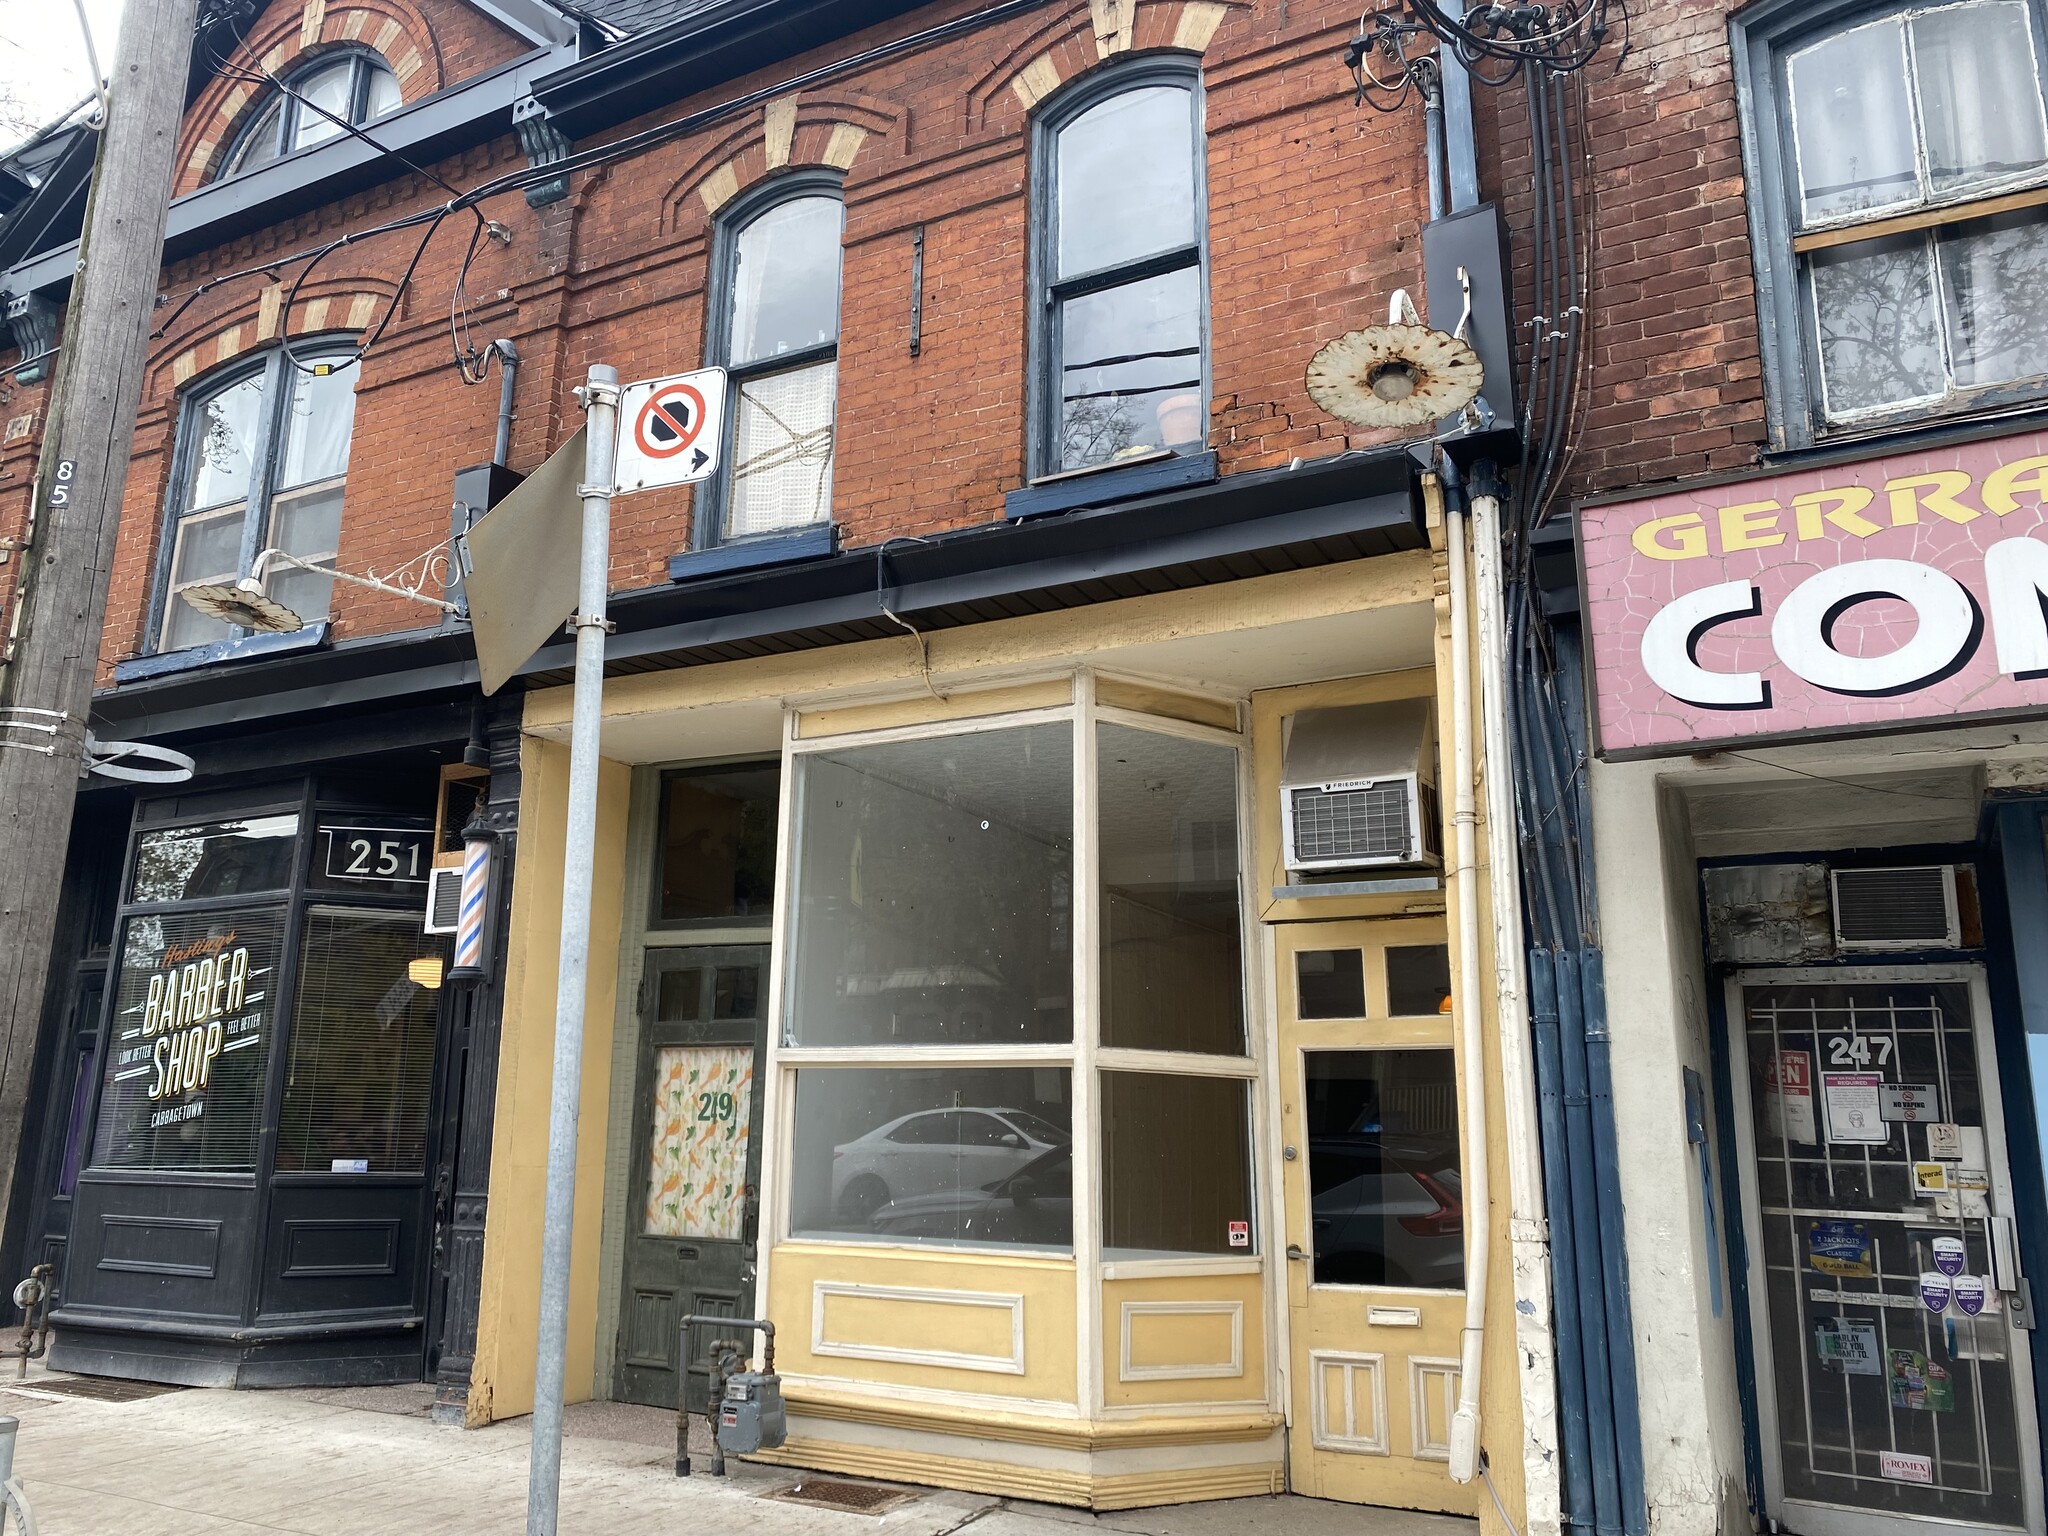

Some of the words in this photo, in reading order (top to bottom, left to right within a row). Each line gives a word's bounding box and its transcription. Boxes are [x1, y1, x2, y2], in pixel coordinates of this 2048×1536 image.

[1333, 780, 1371, 788] FRIEDRICH
[345, 839, 420, 877] 251
[161, 929, 237, 968] Hastings
[142, 947, 249, 1038] BARBER
[226, 1021, 239, 1035] FEEL
[240, 1013, 261, 1031] BETTER
[118, 1048, 132, 1066] LOOK
[132, 1044, 152, 1061] BETTER
[148, 1020, 223, 1101] SHOP
[1827, 1036, 1894, 1066] 247
[150, 1101, 204, 1128] CABBAGETOWN
[1917, 1170, 1943, 1183] Interac
[1823, 1236, 1861, 1244] JACKPOTS
[1923, 1290, 1948, 1298] SECURITY
[1833, 1334, 1859, 1342] PARLAY
[1850, 1342, 1864, 1351] YOU
[1891, 1460, 1926, 1472] ROMEX
